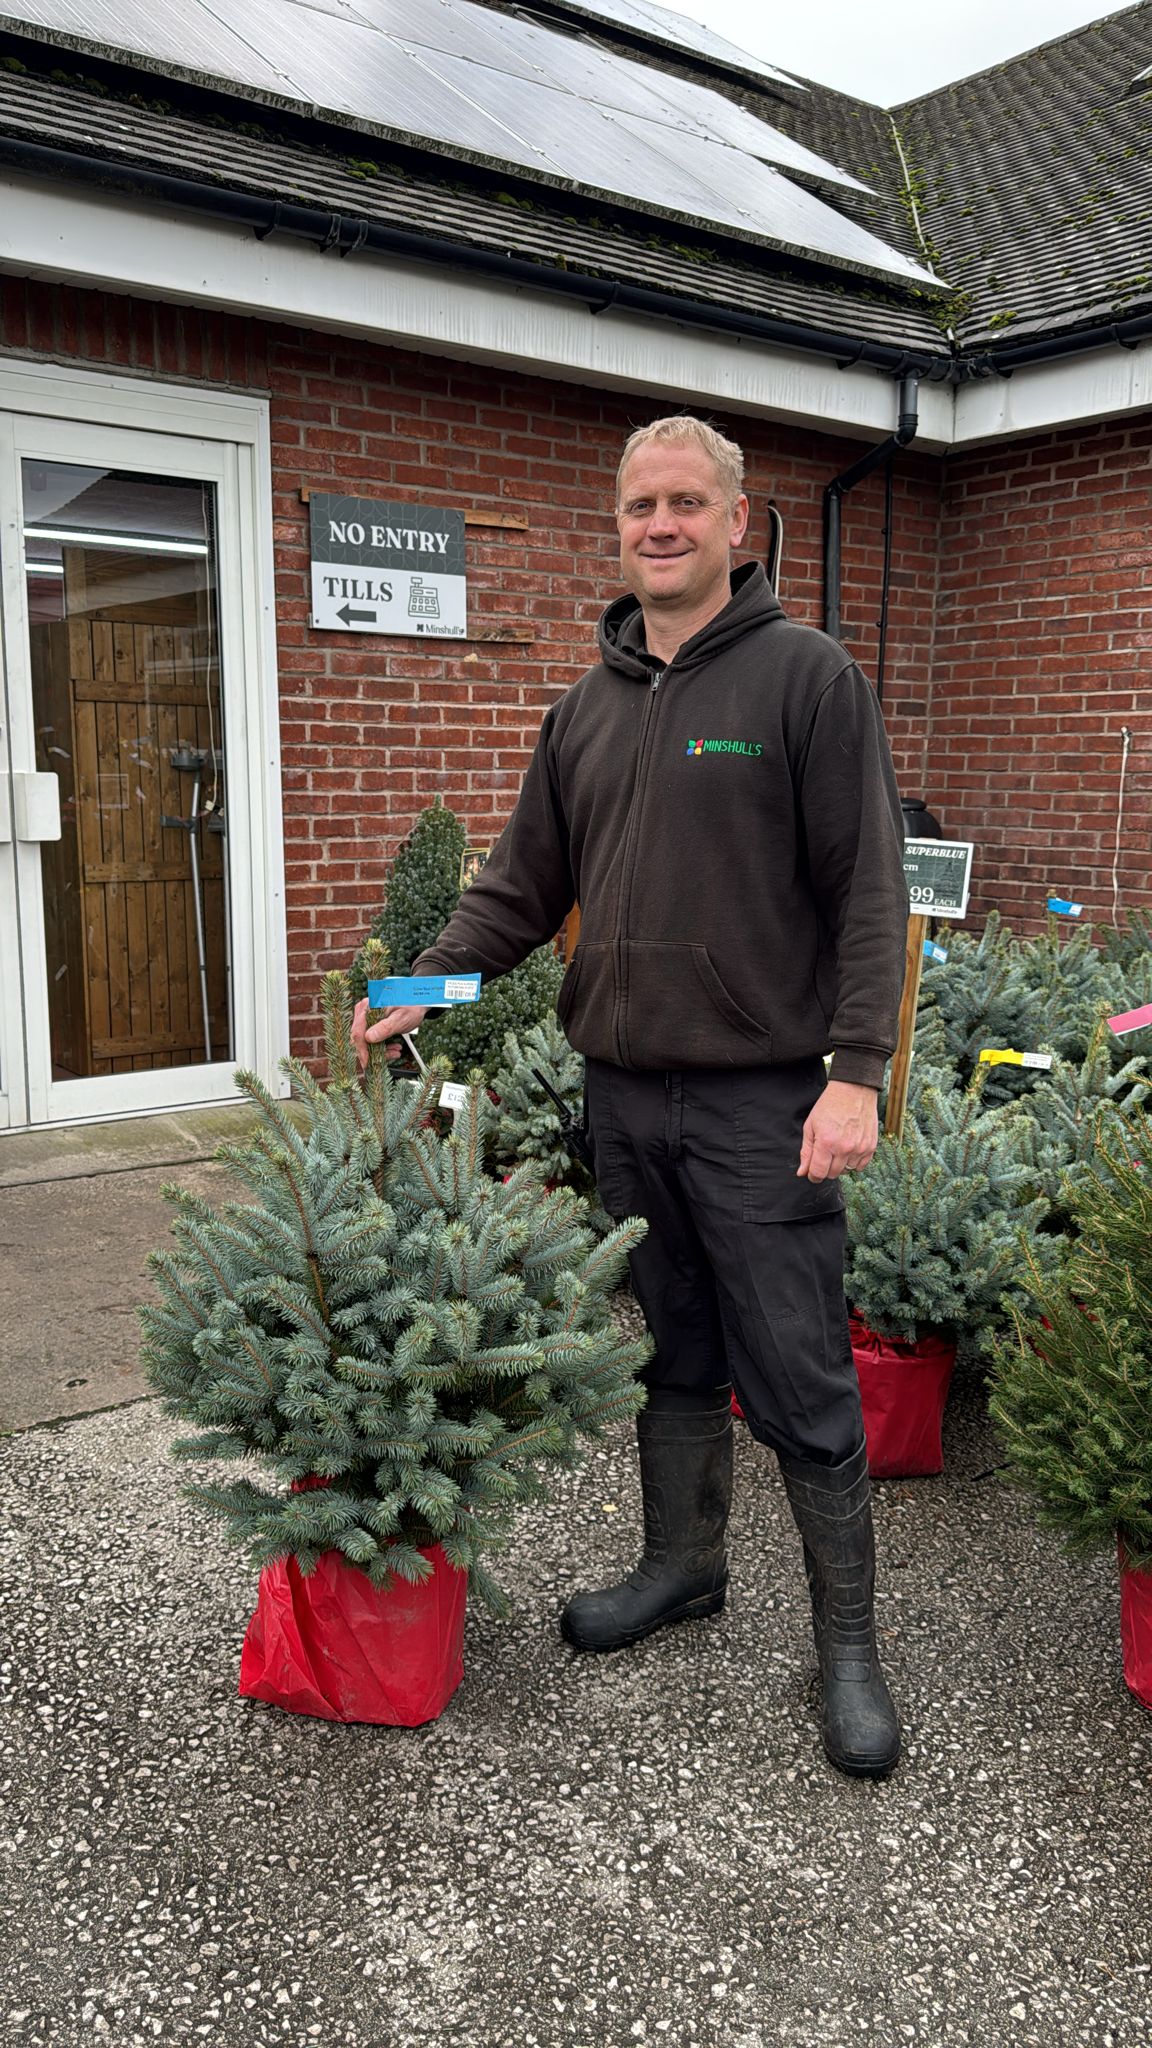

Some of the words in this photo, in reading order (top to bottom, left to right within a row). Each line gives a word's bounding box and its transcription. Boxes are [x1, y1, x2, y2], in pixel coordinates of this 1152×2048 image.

[329, 520, 365, 545] NO
[371, 525, 449, 554] ENTRY
[323, 577, 393, 602] TILLS
[703, 740, 762, 756] MINSHULL'S
[905, 846, 966, 859] SUPERBLUE
[934, 898, 956, 907] EACH
